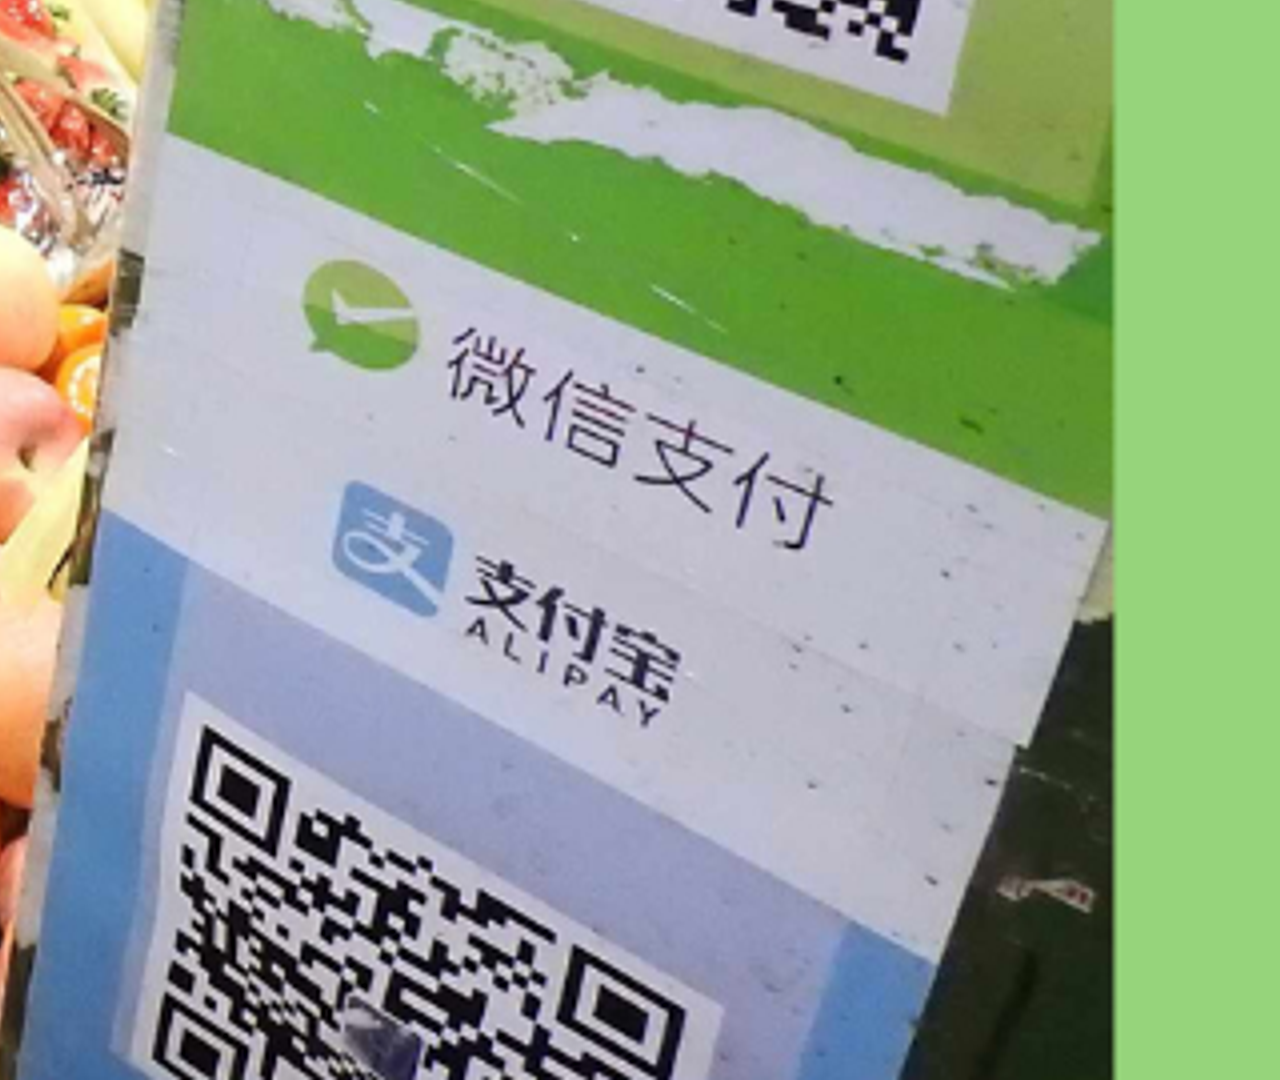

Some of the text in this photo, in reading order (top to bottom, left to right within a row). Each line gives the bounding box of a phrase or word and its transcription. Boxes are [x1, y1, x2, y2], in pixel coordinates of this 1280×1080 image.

[446, 327, 834, 551] 微信支付
[465, 555, 682, 704] 支付宝
[465, 616, 662, 729] ALIPAY
